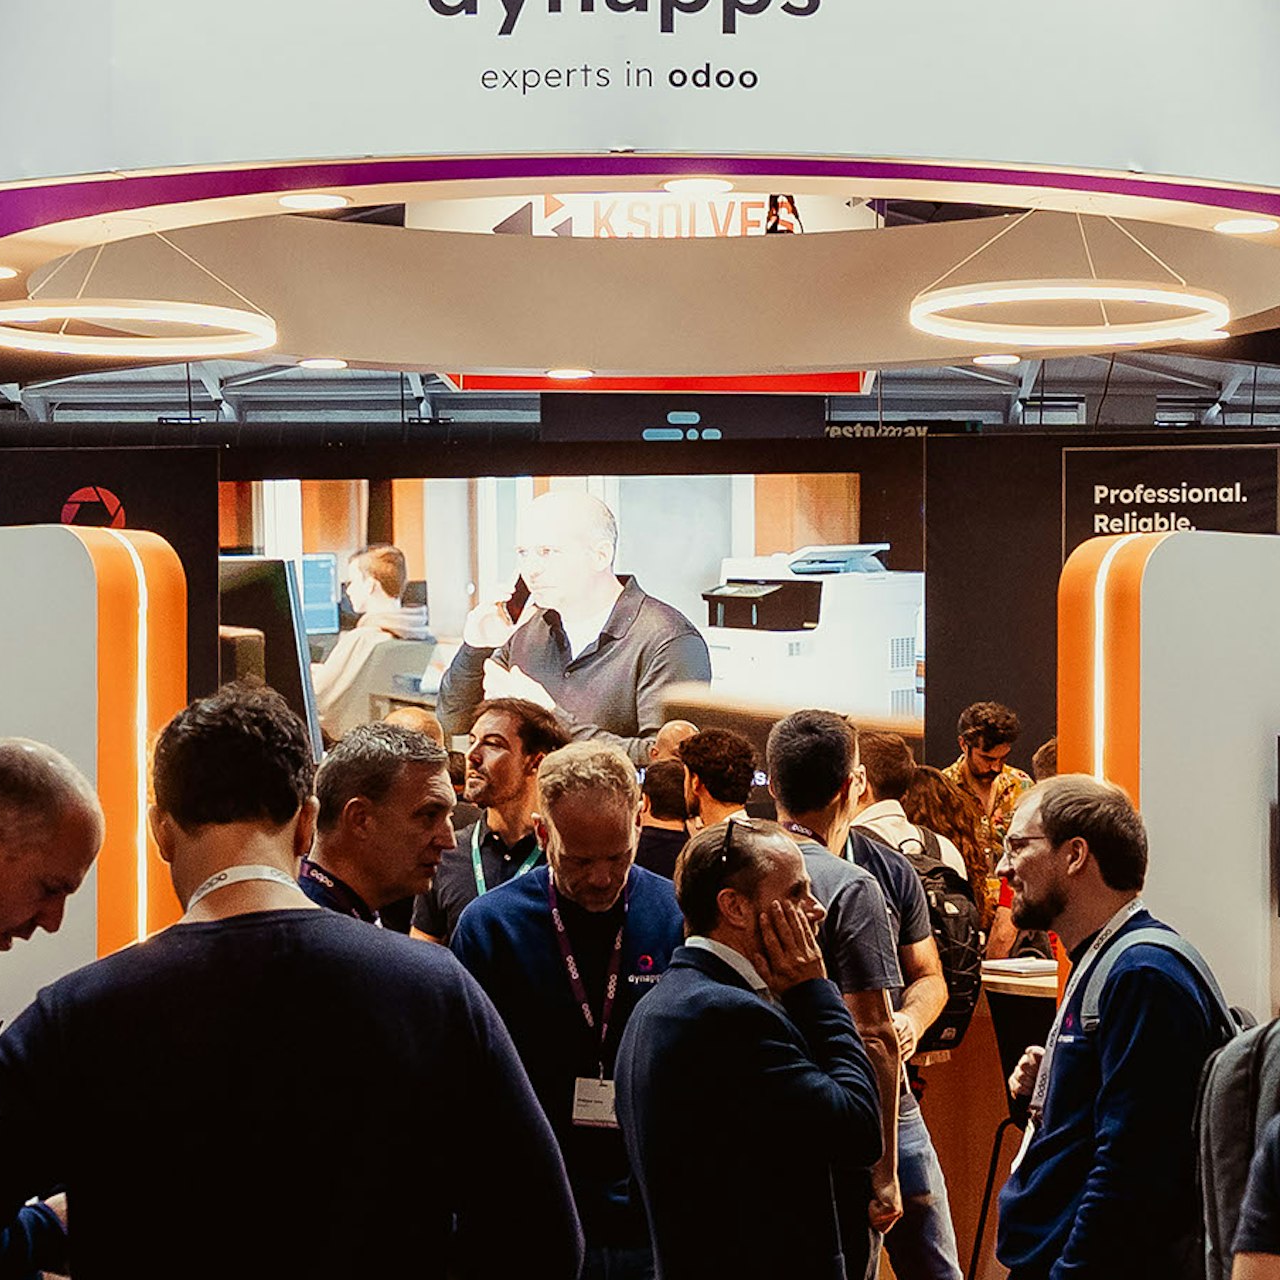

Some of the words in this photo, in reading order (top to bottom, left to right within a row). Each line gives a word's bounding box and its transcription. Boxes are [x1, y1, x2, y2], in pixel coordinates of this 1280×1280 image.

[480, 63, 611, 95] experts
[624, 60, 653, 88] in
[668, 63, 759, 89] odoo
[1093, 481, 1248, 505] Professional.
[1093, 512, 1197, 534] Reliable.
[1093, 928, 1113, 951] odoo
